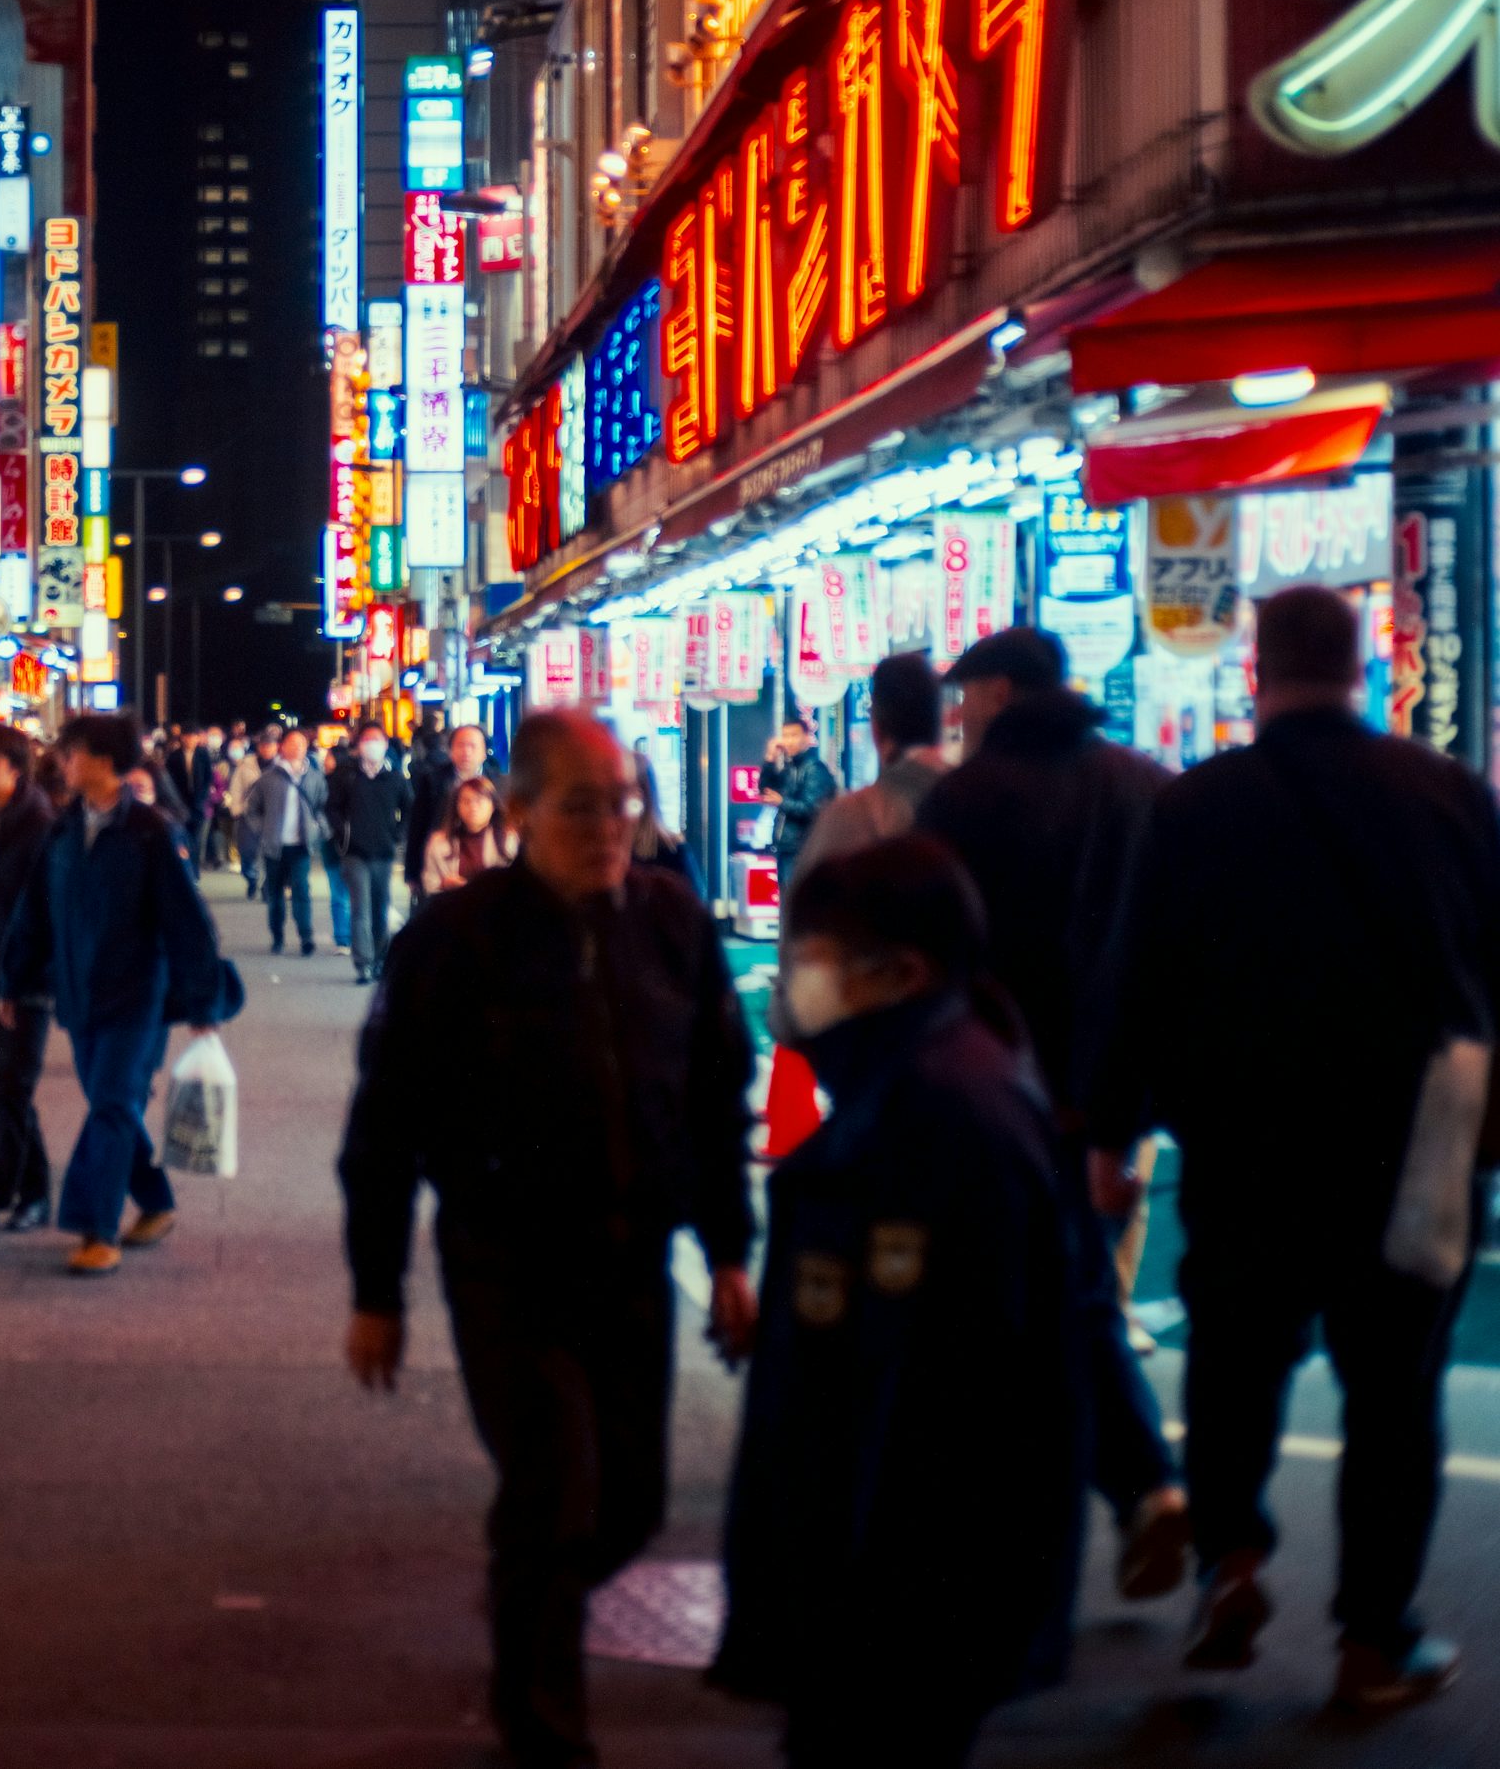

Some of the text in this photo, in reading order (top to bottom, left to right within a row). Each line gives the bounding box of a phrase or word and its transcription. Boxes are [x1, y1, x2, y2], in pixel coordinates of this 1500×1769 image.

[330, 20, 355, 116] カラオケ
[43, 217, 81, 437] ヨドバシカメラ
[44, 452, 79, 547] 時計館
